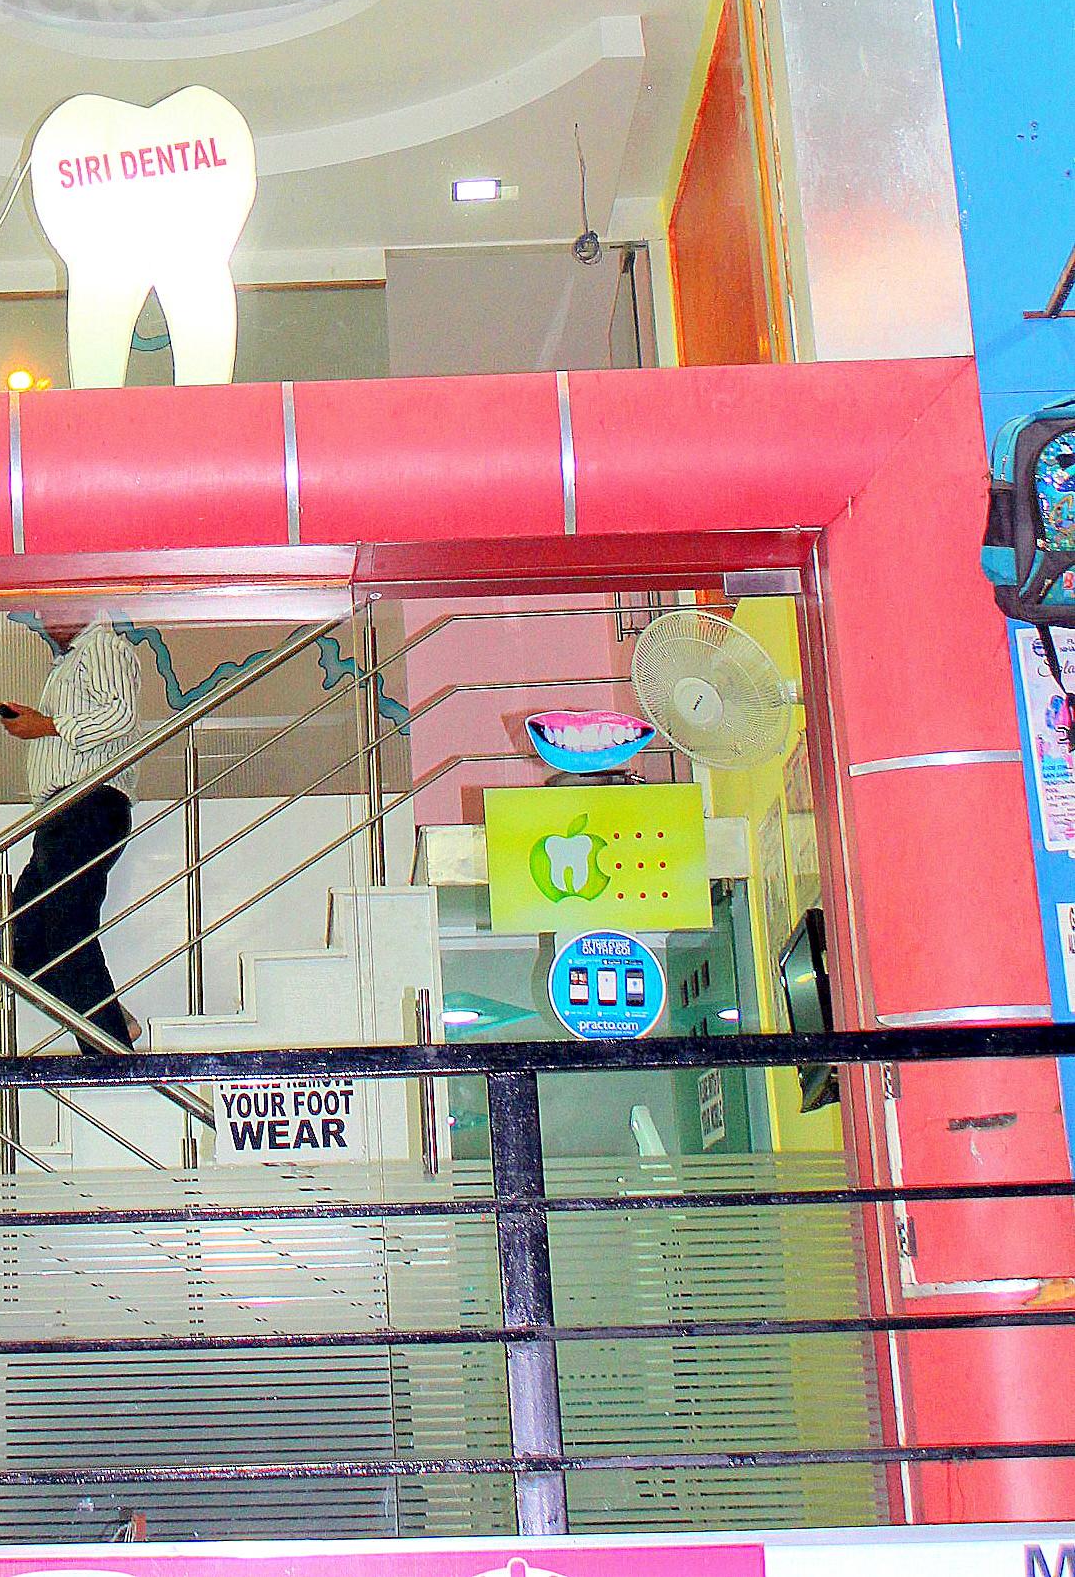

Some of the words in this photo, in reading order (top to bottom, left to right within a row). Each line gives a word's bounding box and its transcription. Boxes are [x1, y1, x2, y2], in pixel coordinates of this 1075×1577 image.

[58, 153, 112, 189] SIRI
[120, 137, 227, 180] DENTAL
[598, 946, 613, 955] THE
[221, 1092, 286, 1119] YOUR
[293, 1090, 354, 1117] FOOT
[229, 1118, 348, 1151] WEAR
